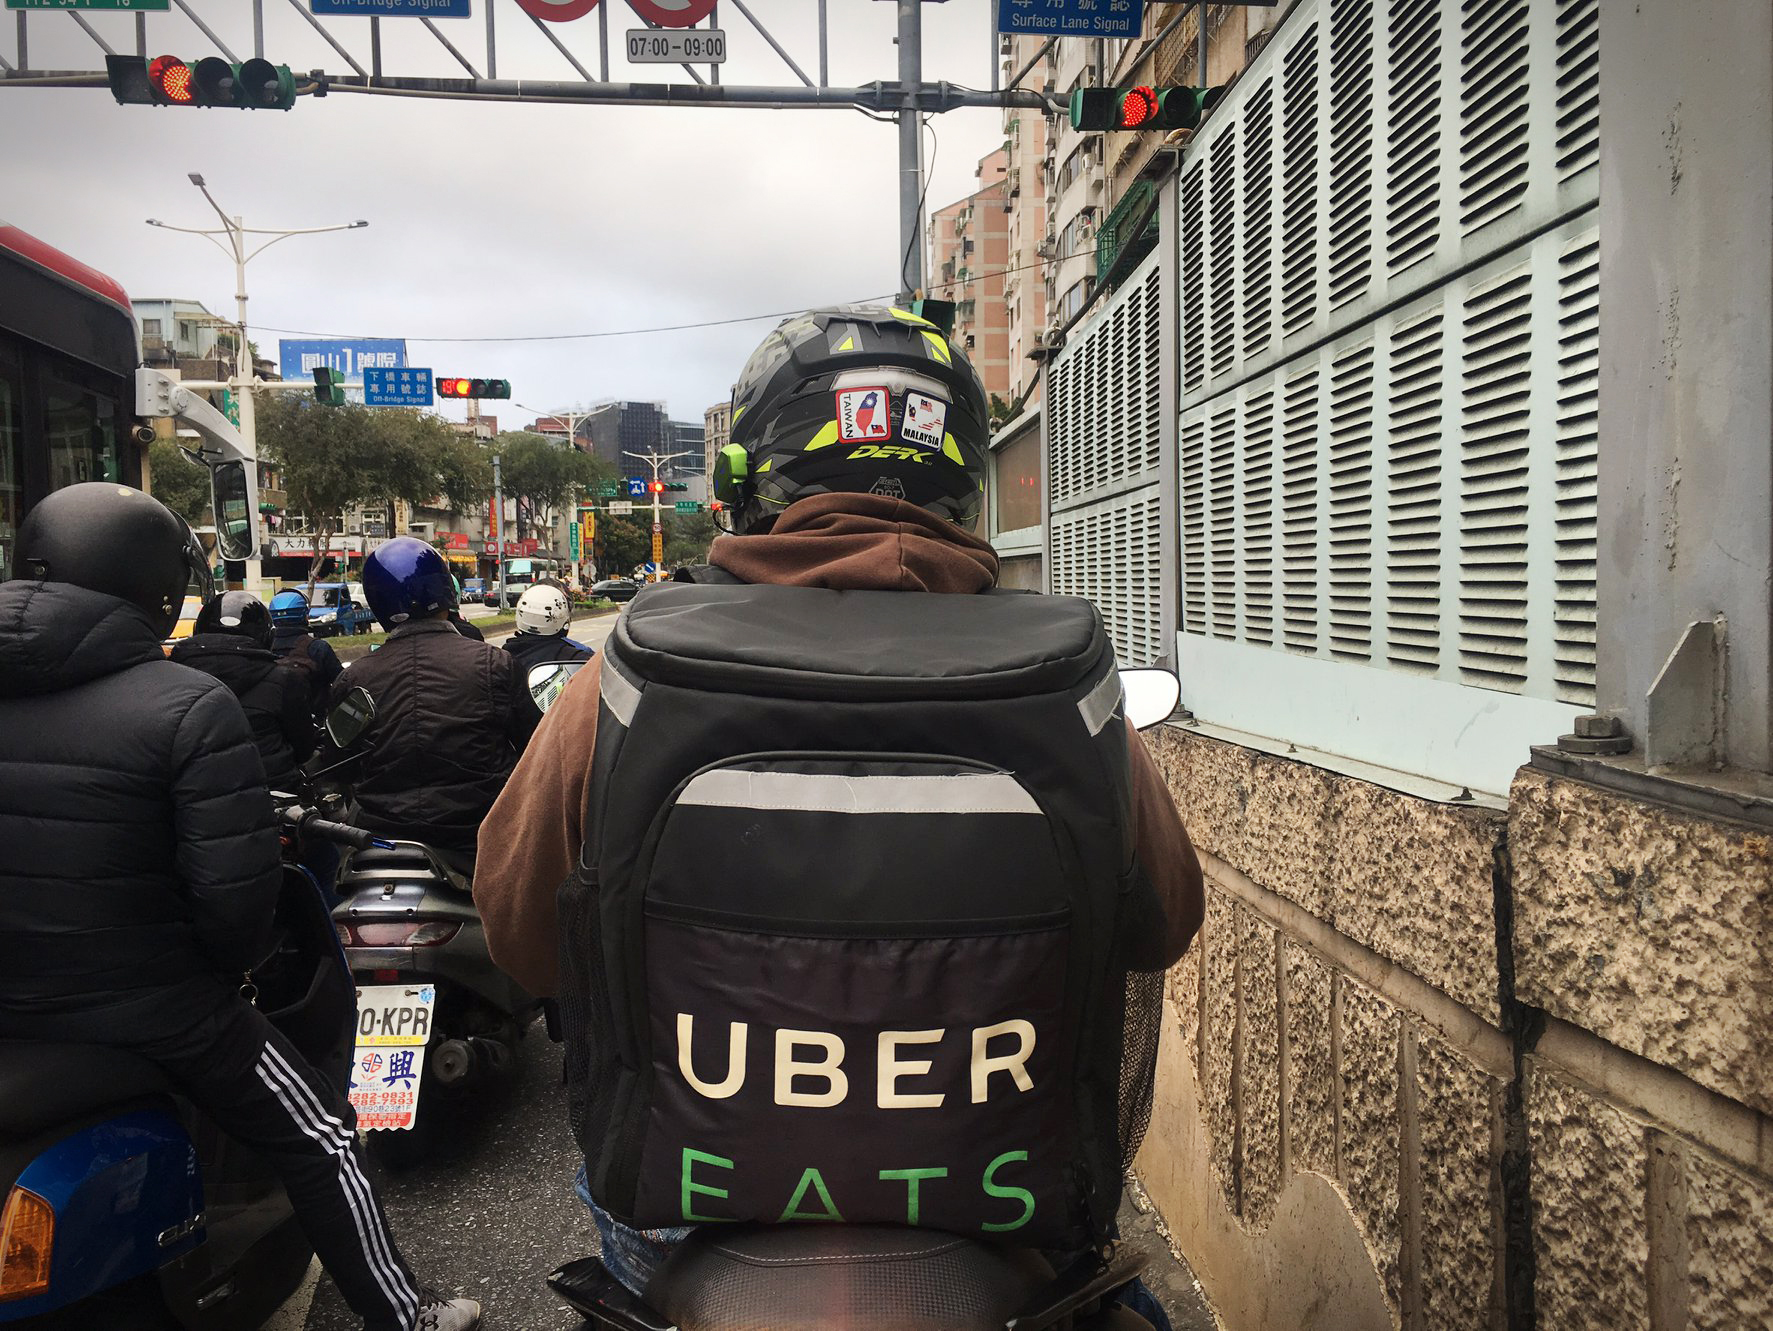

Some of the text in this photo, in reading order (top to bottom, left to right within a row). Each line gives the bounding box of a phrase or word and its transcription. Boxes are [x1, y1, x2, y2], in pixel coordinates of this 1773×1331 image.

[1012, 12, 1130, 33] Surface Lane Signal
[369, 371, 428, 383] 下橋車輛
[369, 384, 427, 395] 專用號誌
[373, 396, 426, 404] Off-Bridge Signal
[843, 394, 854, 438] TAIWAN
[903, 428, 940, 447] MALAYSIA
[876, 488, 902, 498] DOT
[356, 1007, 429, 1036] 0-KPR
[381, 1050, 417, 1090] 興
[676, 1012, 1037, 1109] UBER
[680, 1146, 1036, 1233] EATS
